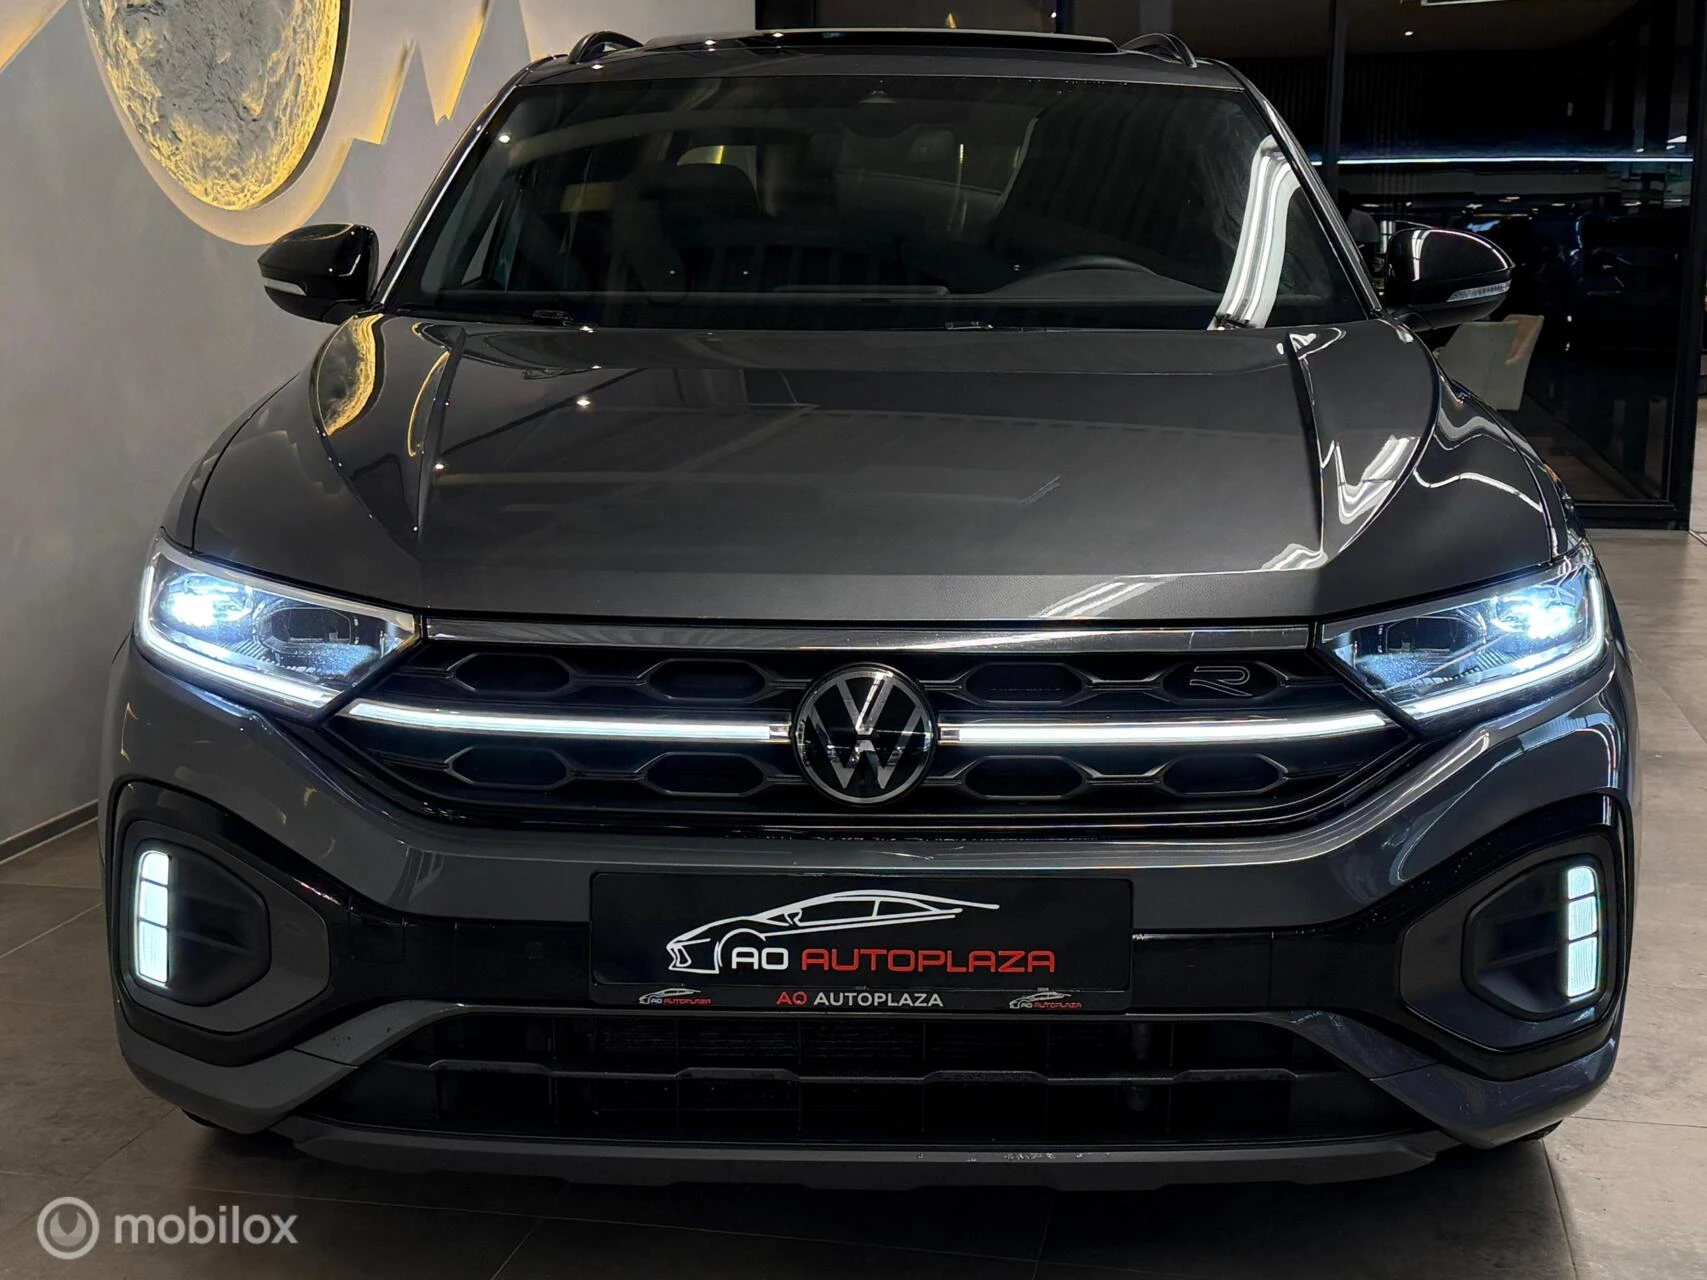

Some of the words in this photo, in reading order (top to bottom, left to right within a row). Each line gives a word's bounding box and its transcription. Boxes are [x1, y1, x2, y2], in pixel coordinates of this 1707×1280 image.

[731, 946, 789, 971] AO
[801, 948, 1056, 974] AUTOPLAZA
[813, 992, 944, 1007] AUTOPLAZA
